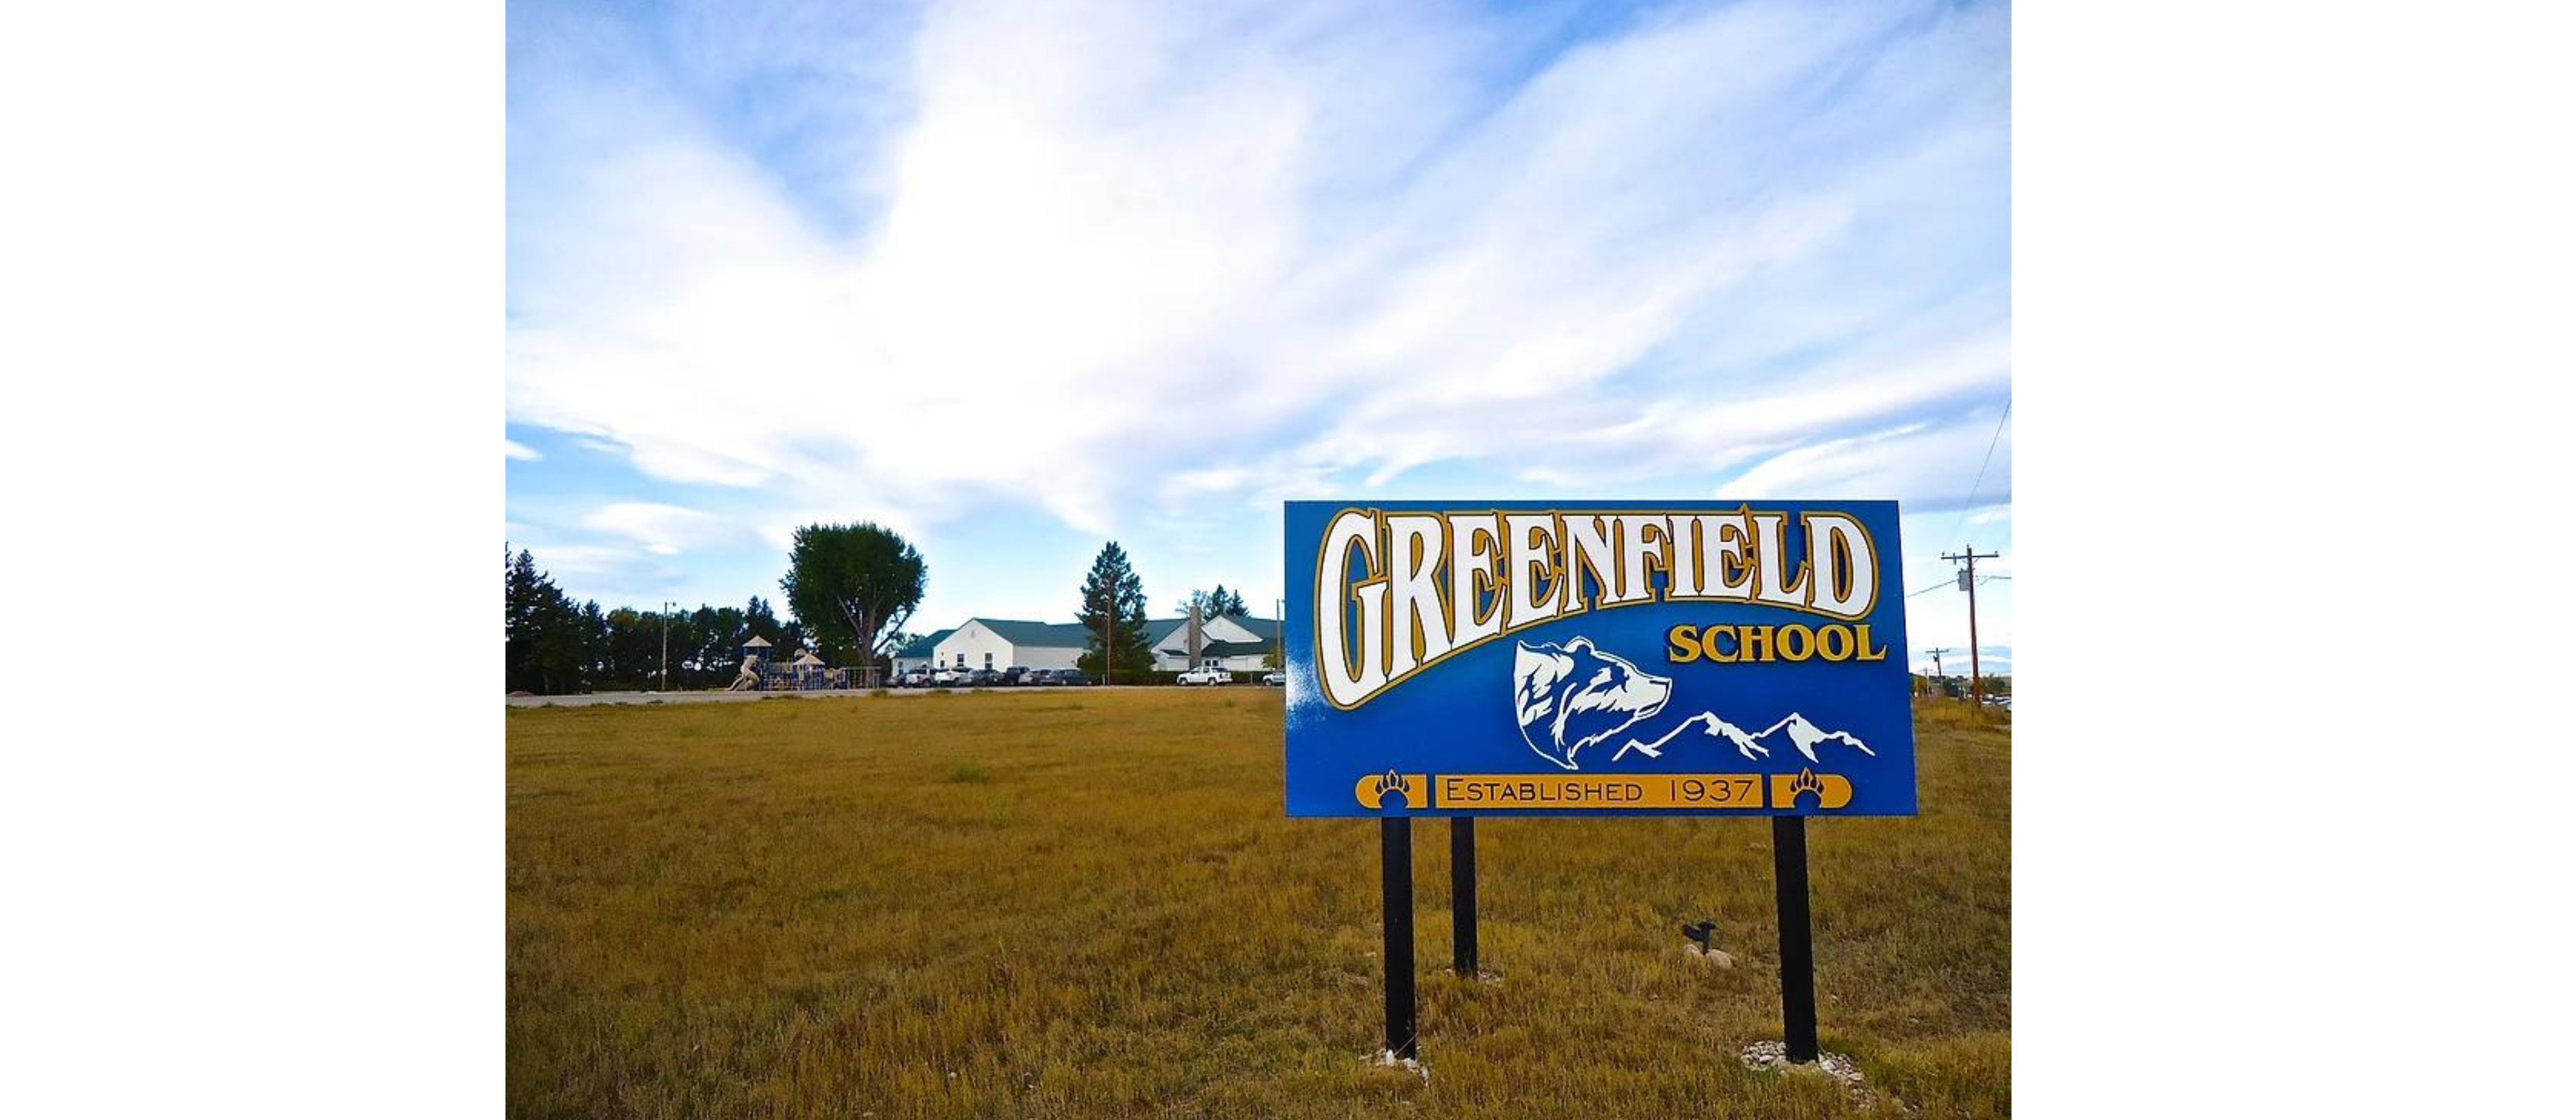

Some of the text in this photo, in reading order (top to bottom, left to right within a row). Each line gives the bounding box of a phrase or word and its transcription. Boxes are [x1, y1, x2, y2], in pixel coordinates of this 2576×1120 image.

[1313, 504, 1880, 710] GREENFIELD
[1668, 624, 1886, 663] SCHOOL
[1446, 778, 1754, 802] ESTABLISHED 1937
